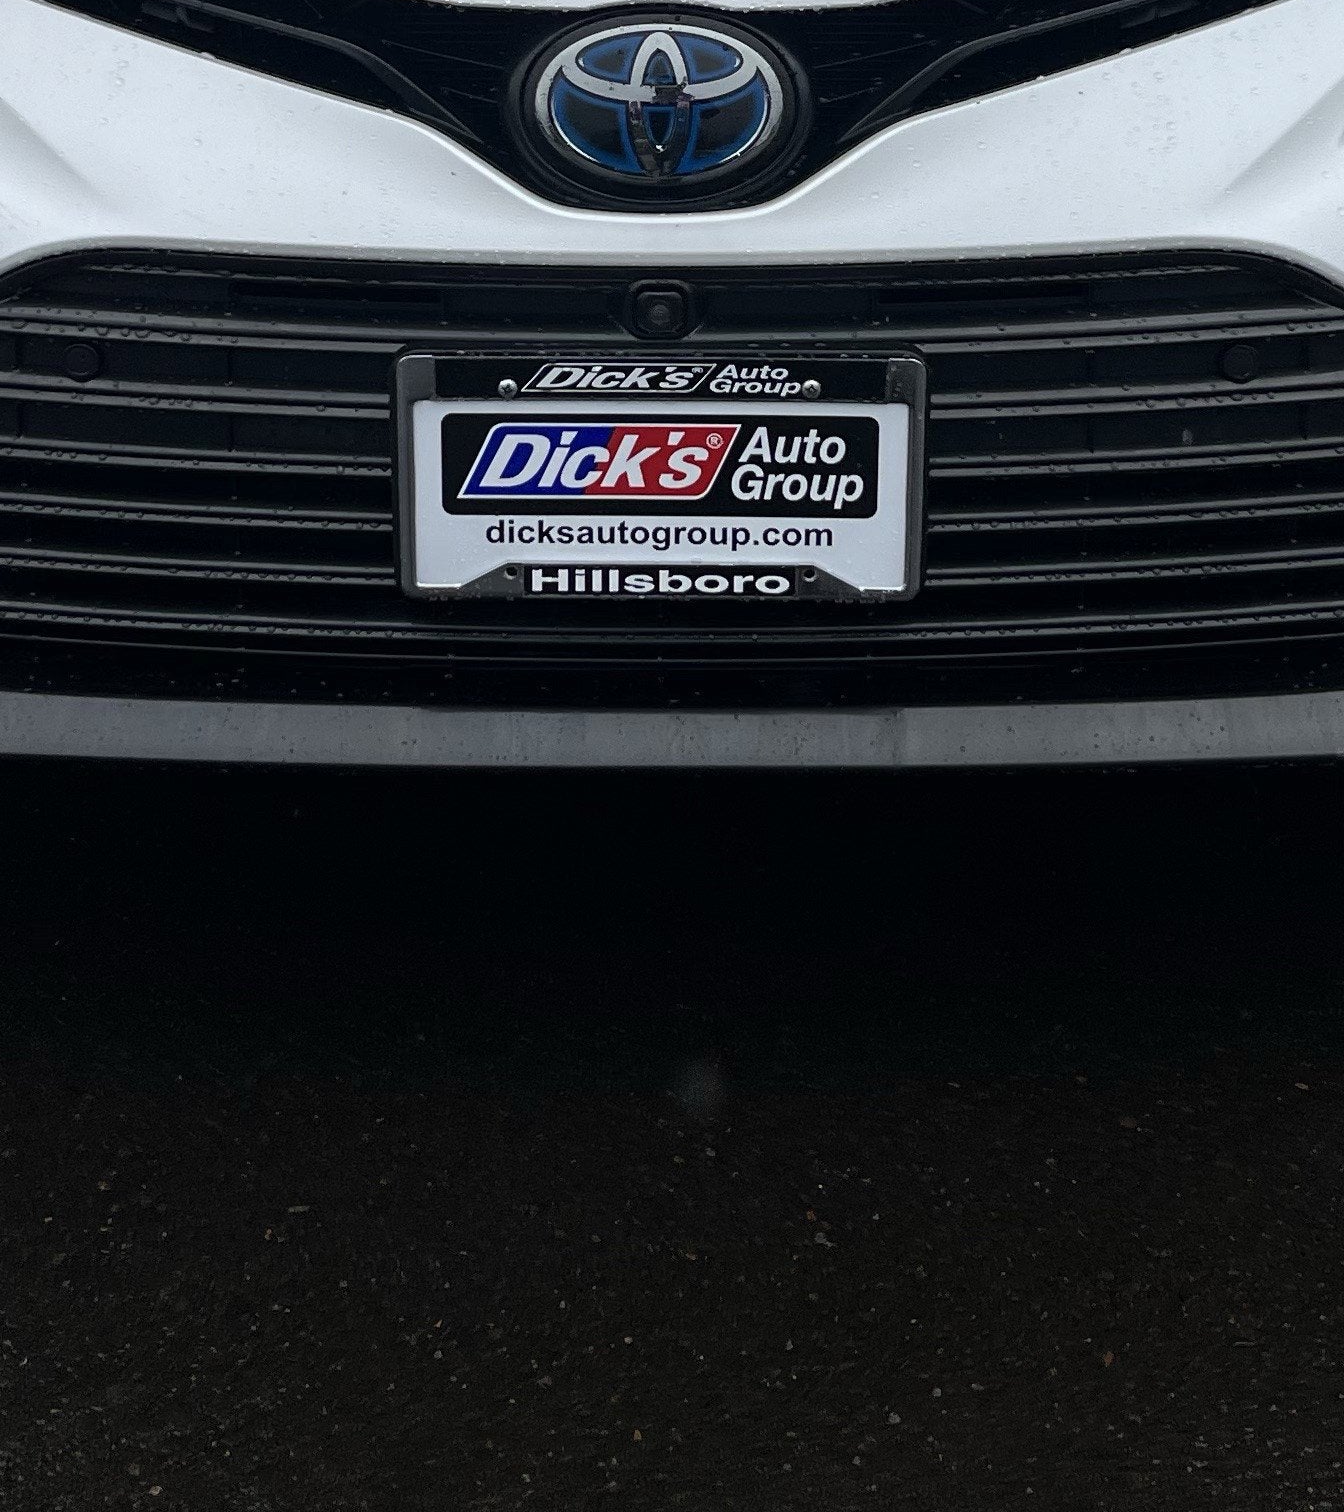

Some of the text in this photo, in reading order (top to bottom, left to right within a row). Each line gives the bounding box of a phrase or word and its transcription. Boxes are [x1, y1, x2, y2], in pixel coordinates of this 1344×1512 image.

[709, 378, 802, 397] Group
[716, 364, 789, 380] Auto
[478, 430, 710, 489] Dick's
[738, 426, 847, 465] Auto
[731, 463, 864, 510] Group
[485, 519, 833, 552] dicksautogroup.com
[531, 568, 791, 595] Hillsboro
